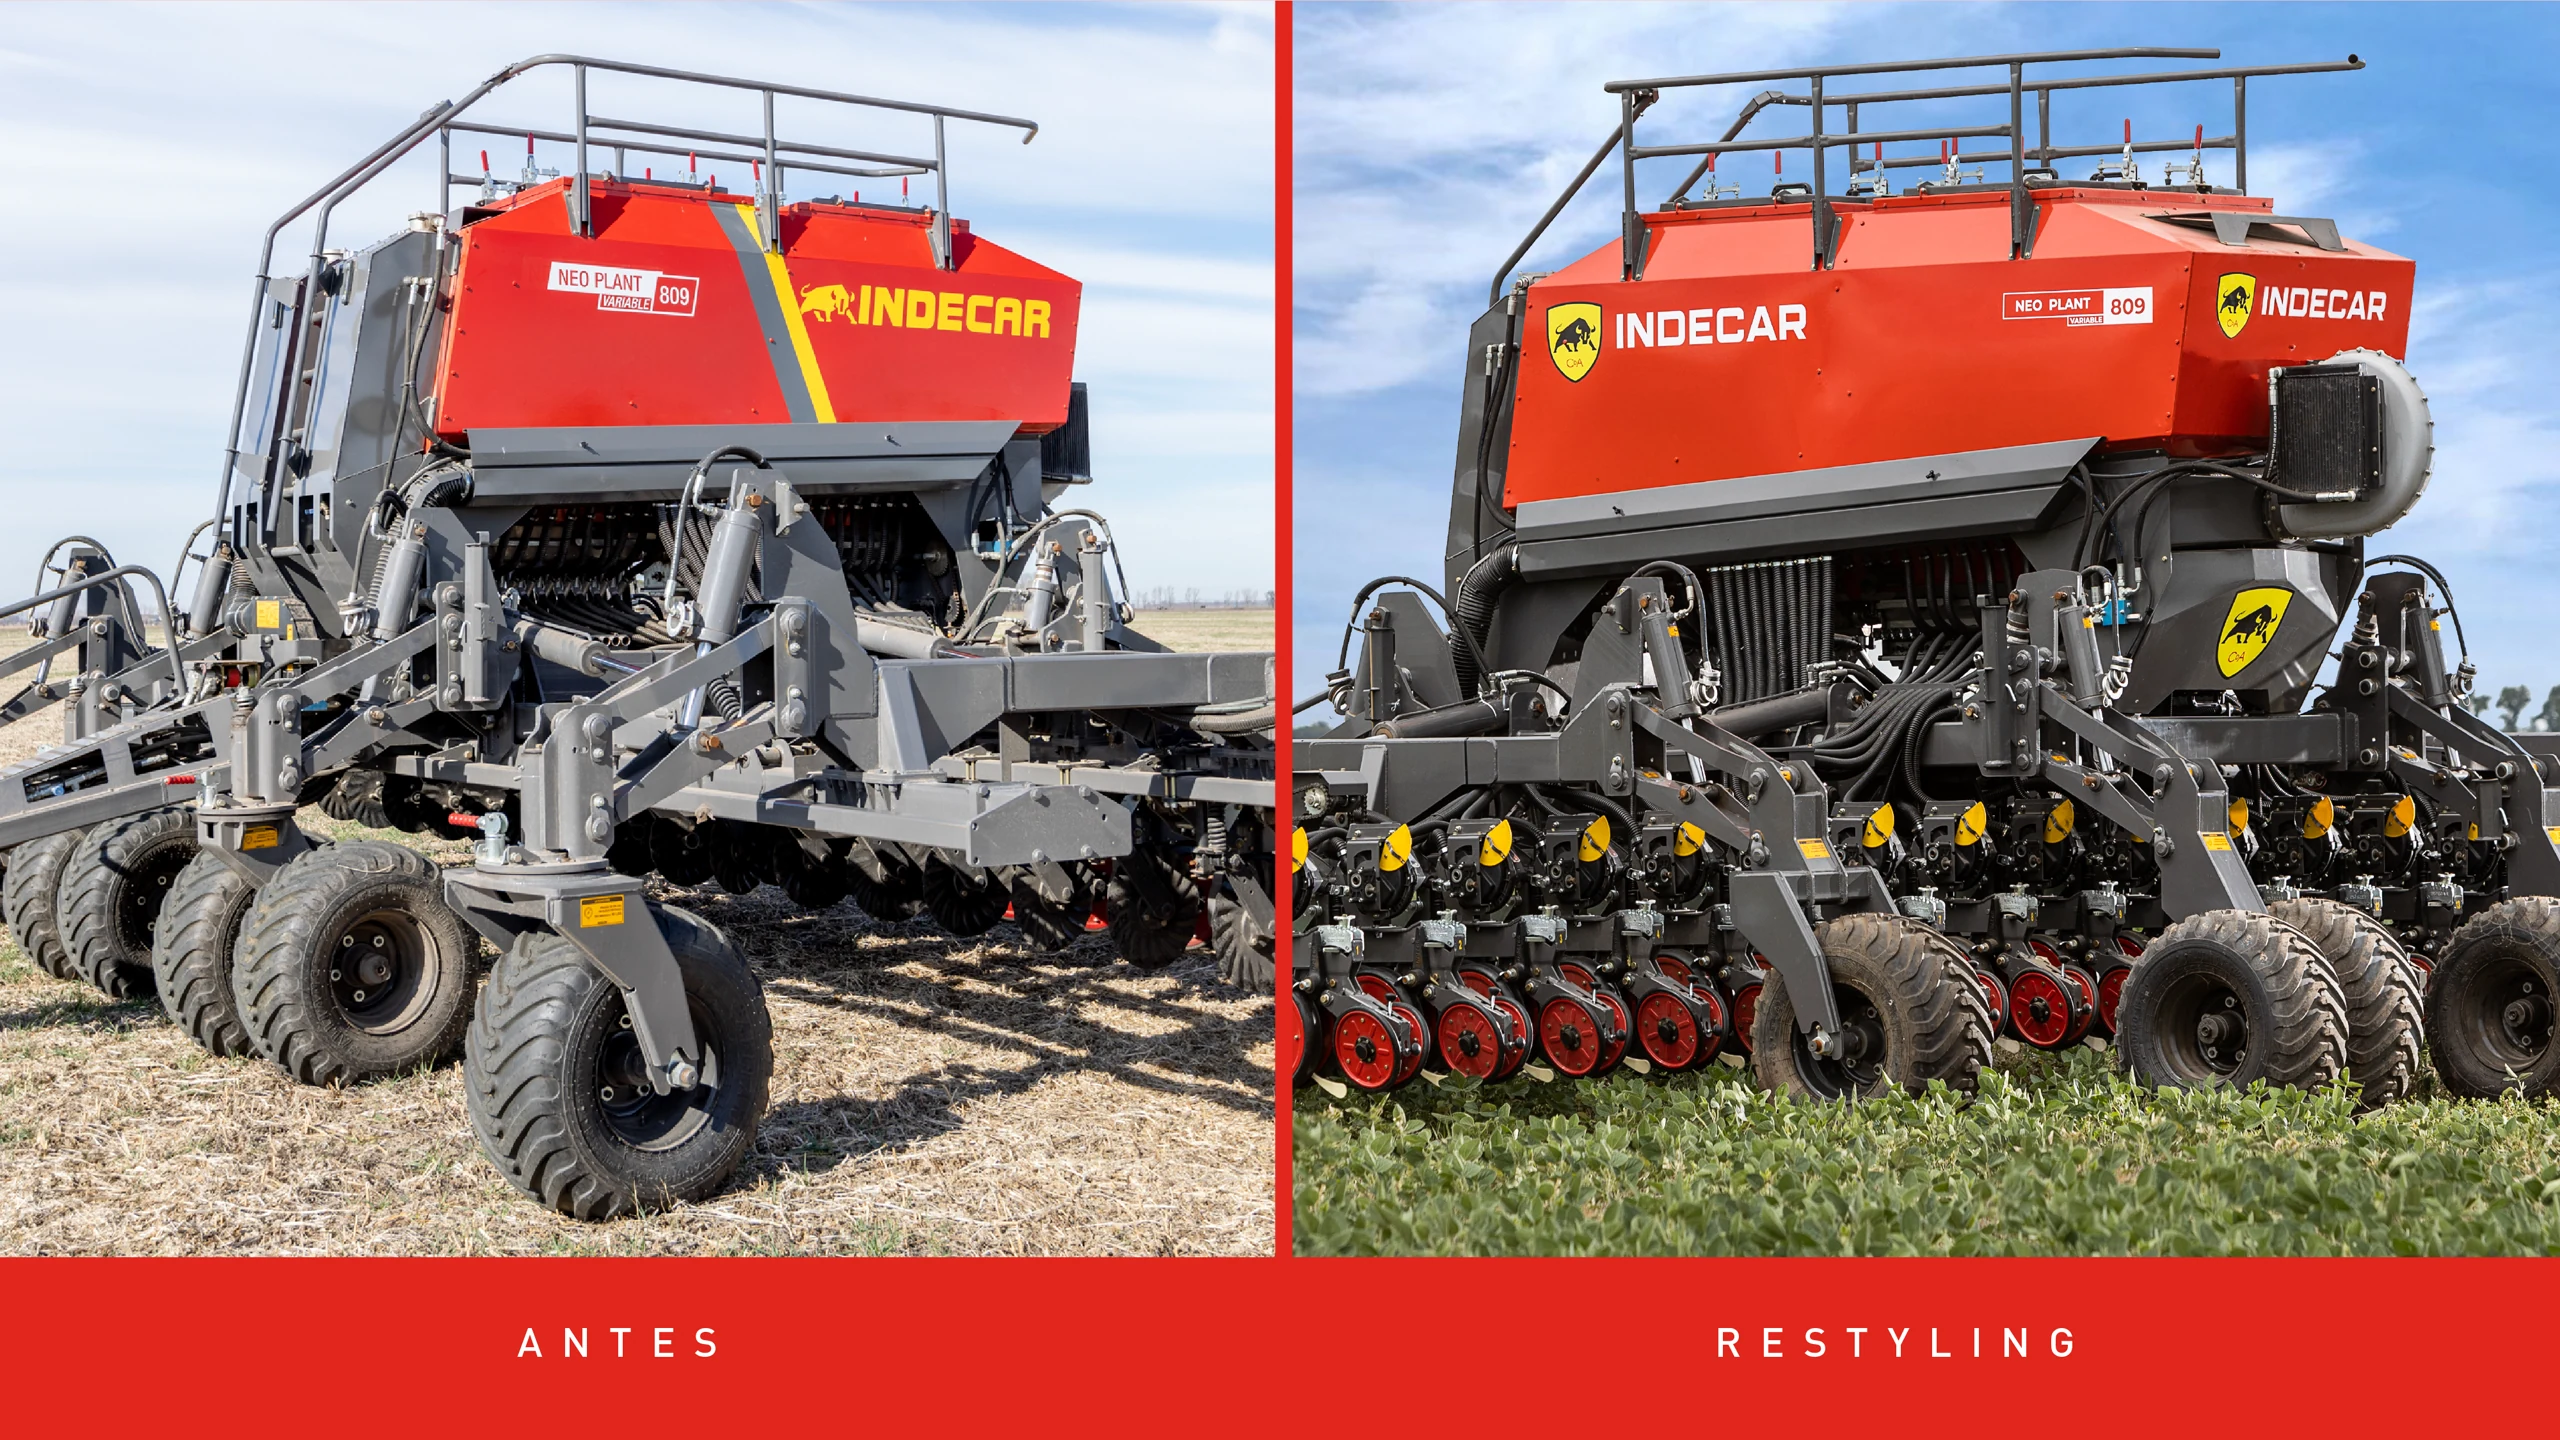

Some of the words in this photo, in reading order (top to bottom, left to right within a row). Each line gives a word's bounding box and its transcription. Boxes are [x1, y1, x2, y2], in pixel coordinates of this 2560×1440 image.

[558, 269, 589, 287] NEO
[594, 272, 643, 291] PLANT
[602, 294, 650, 310] VARIABLE
[659, 285, 690, 306] 809
[2015, 299, 2043, 312] NEO
[2049, 297, 2091, 311] PLANT
[2261, 286, 2387, 321] INDECAR
[858, 285, 1051, 338] INDECAR
[2110, 297, 2146, 316] 809
[1616, 303, 1807, 349] INDECAR
[2069, 316, 2103, 324] VARIABLE
